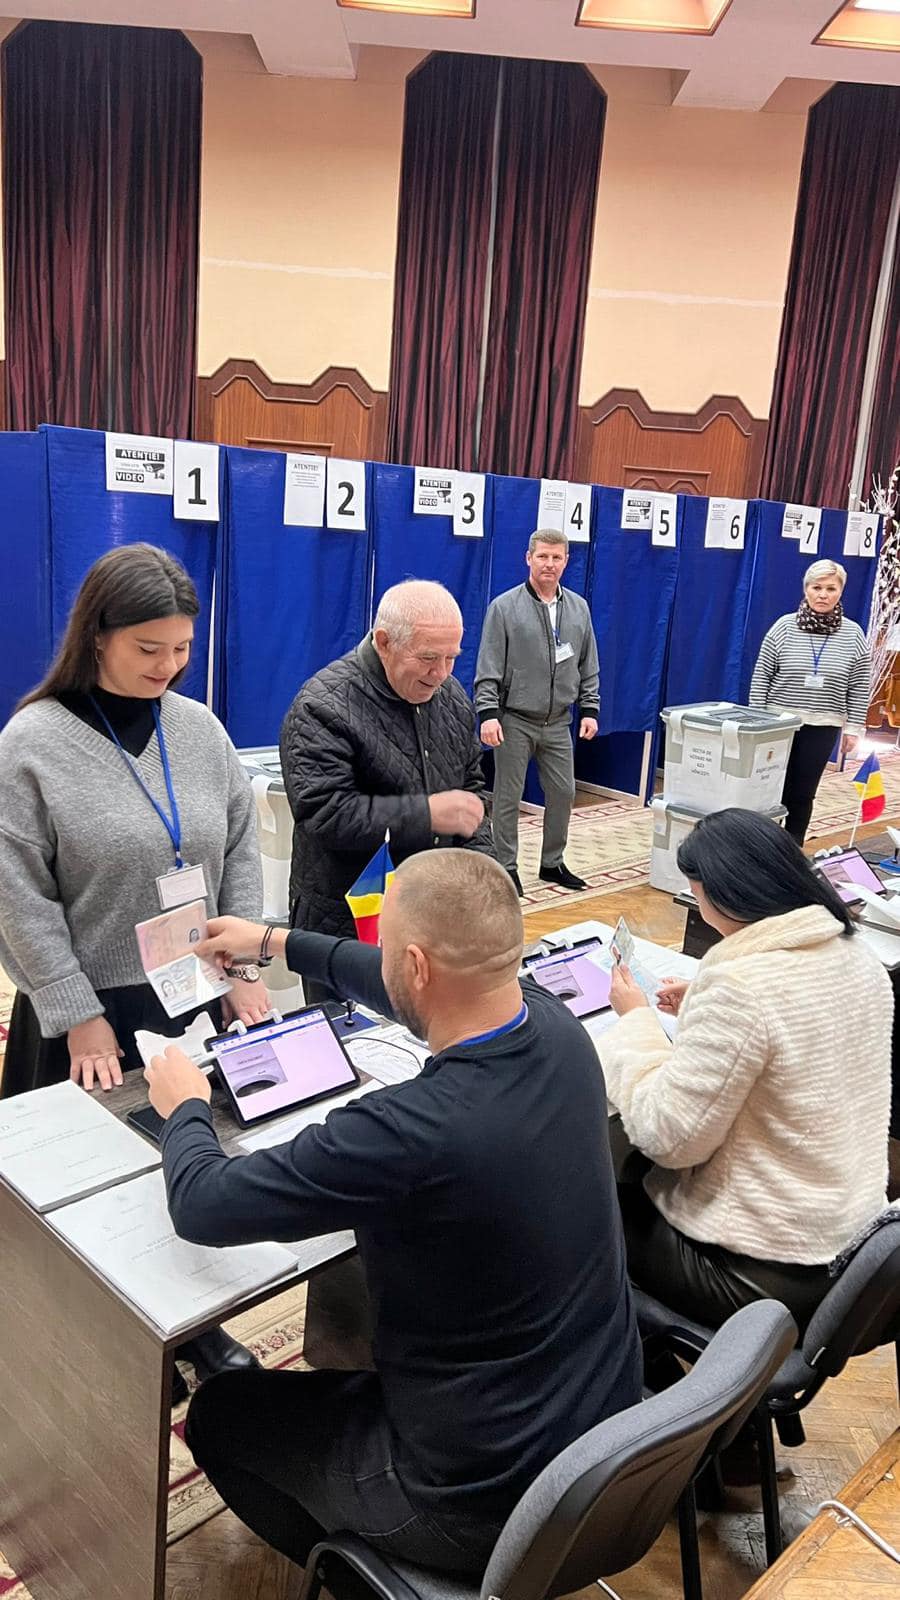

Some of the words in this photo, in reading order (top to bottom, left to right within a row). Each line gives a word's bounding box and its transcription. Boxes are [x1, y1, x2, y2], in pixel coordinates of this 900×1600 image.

[116, 472, 145, 483] VIDEO
[188, 467, 207, 505] 1
[337, 481, 355, 517] 2
[419, 497, 438, 507] VIDEO
[462, 492, 476, 524] 3
[570, 502, 584, 530] 4
[658, 510, 670, 536] 5
[730, 515, 740, 540] 6
[806, 521, 816, 545] 7
[864, 527, 873, 549] 8
